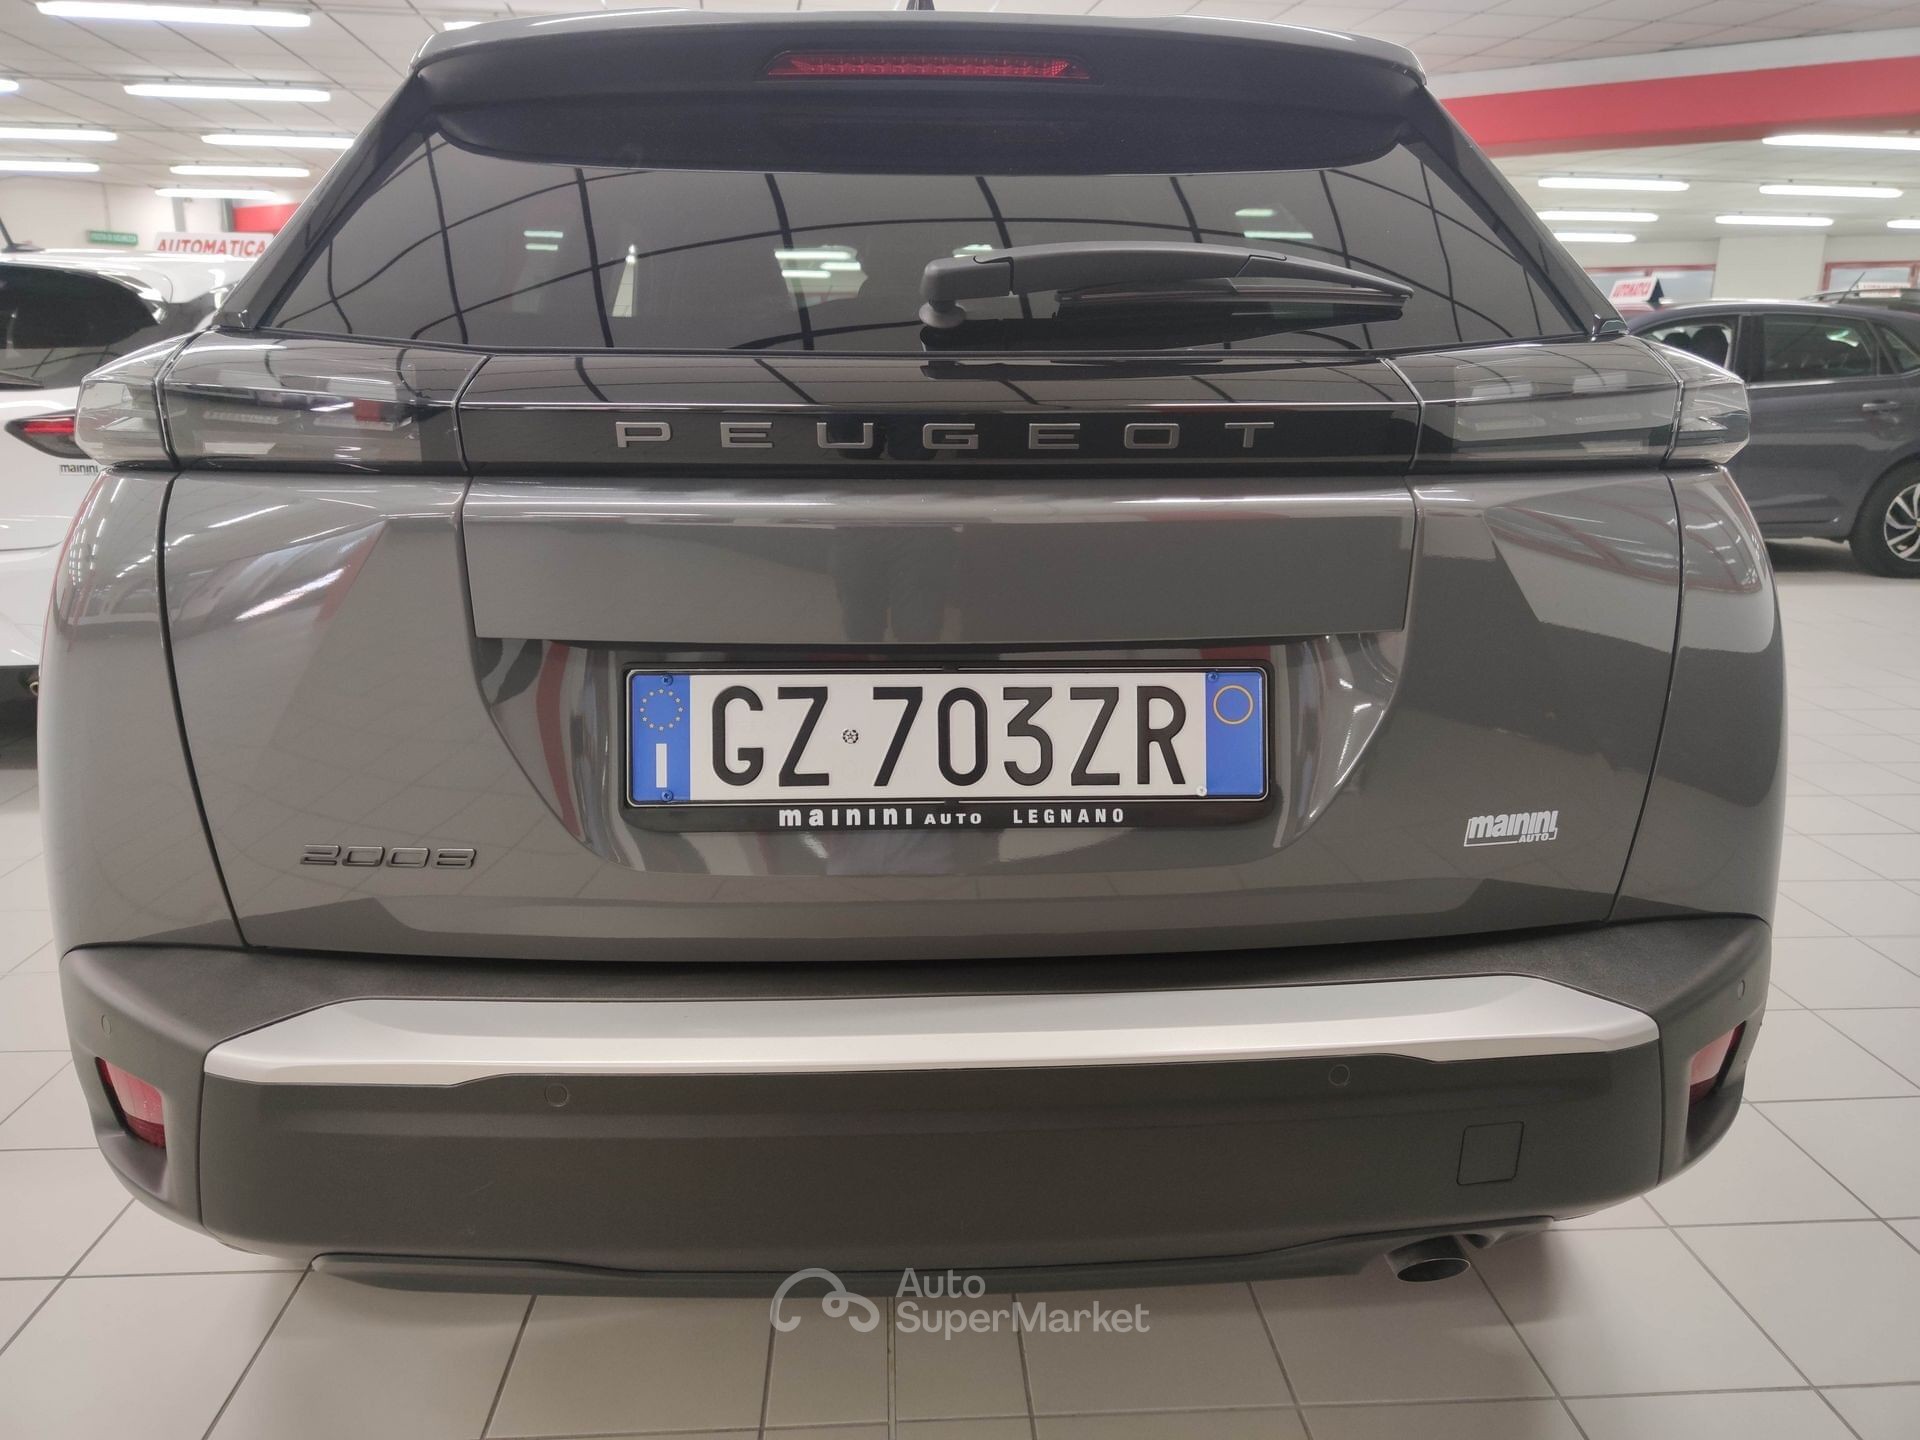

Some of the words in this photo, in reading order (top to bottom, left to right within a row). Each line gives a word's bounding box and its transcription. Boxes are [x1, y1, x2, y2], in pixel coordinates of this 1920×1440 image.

[616, 421, 1274, 450] PEUGEOT
[711, 686, 829, 787] GZ
[924, 813, 982, 825] AUTO
[1013, 808, 1124, 825] LEGNANO
[1518, 832, 1550, 843] AUTO
[300, 844, 476, 870] 2008
